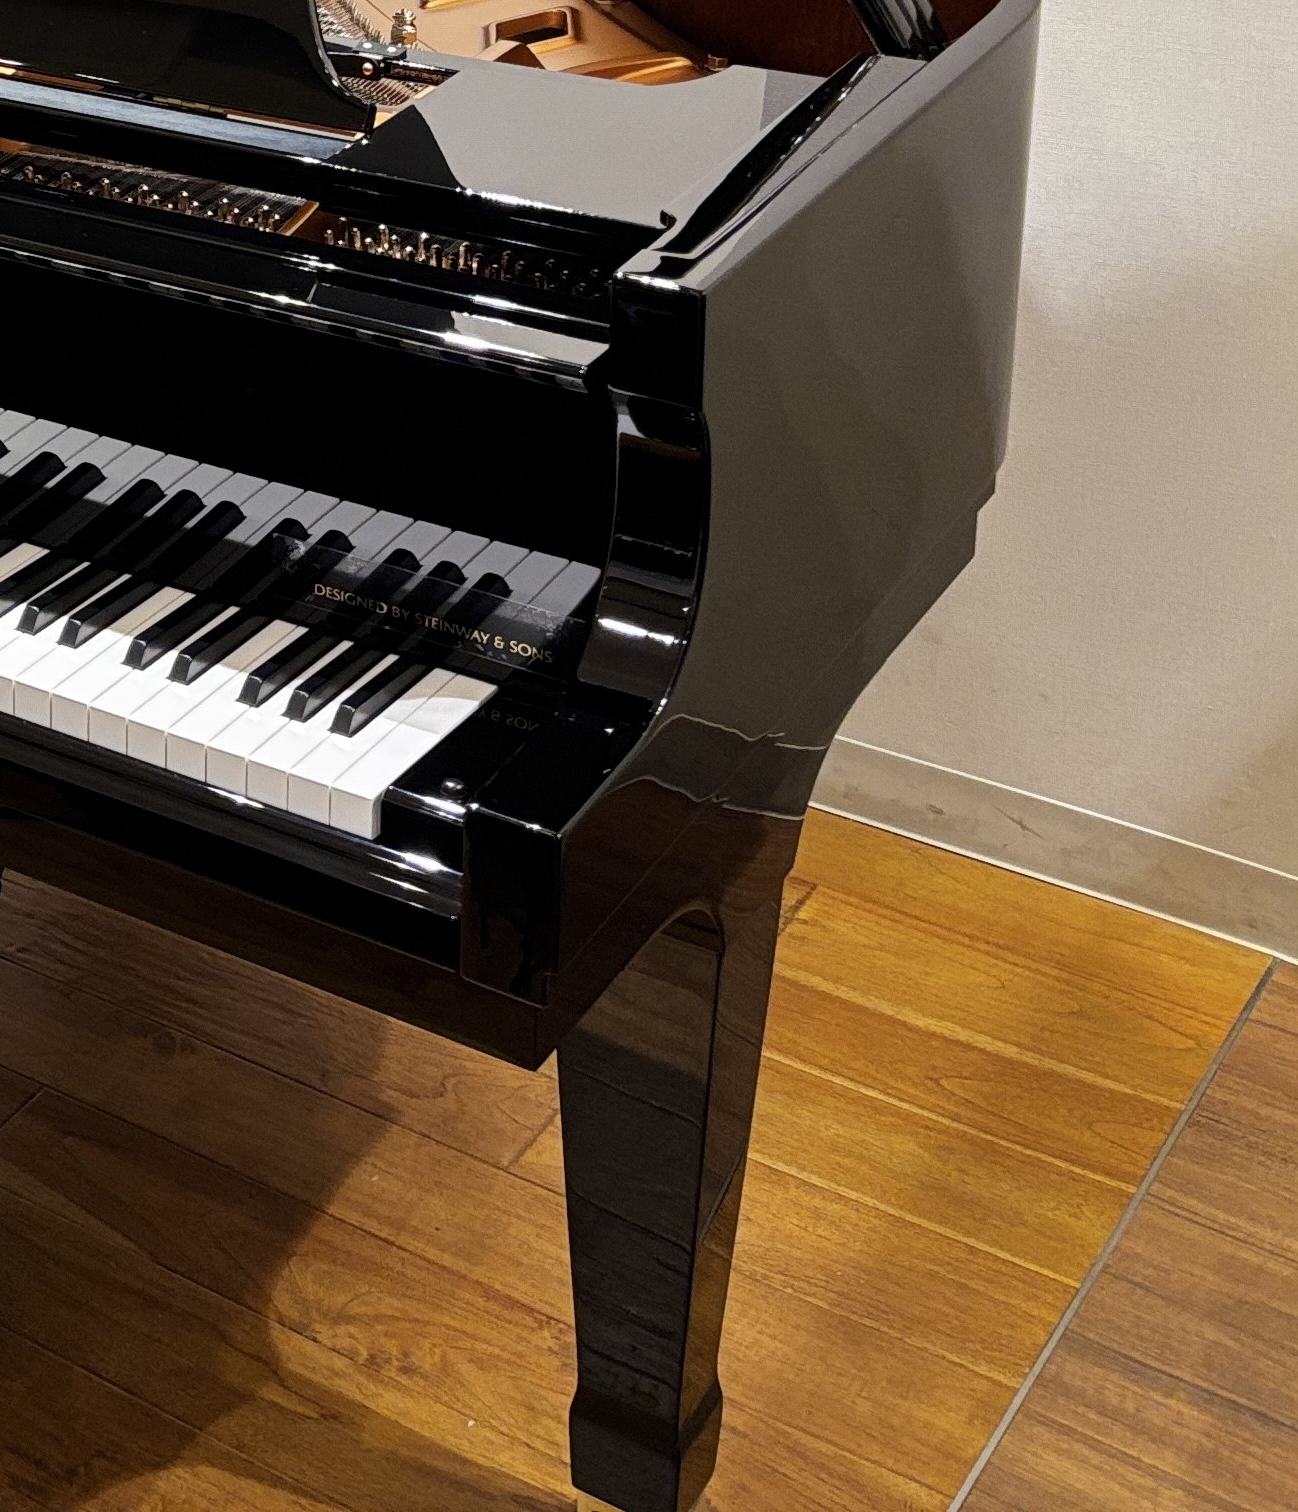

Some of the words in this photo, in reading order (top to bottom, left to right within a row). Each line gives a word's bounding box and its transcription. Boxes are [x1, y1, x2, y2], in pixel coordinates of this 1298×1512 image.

[314, 583, 388, 614] DESIGNED
[392, 604, 410, 620] BY
[415, 612, 490, 644] STEINWAY
[494, 636, 505, 648] &
[509, 640, 553, 663] SONS
